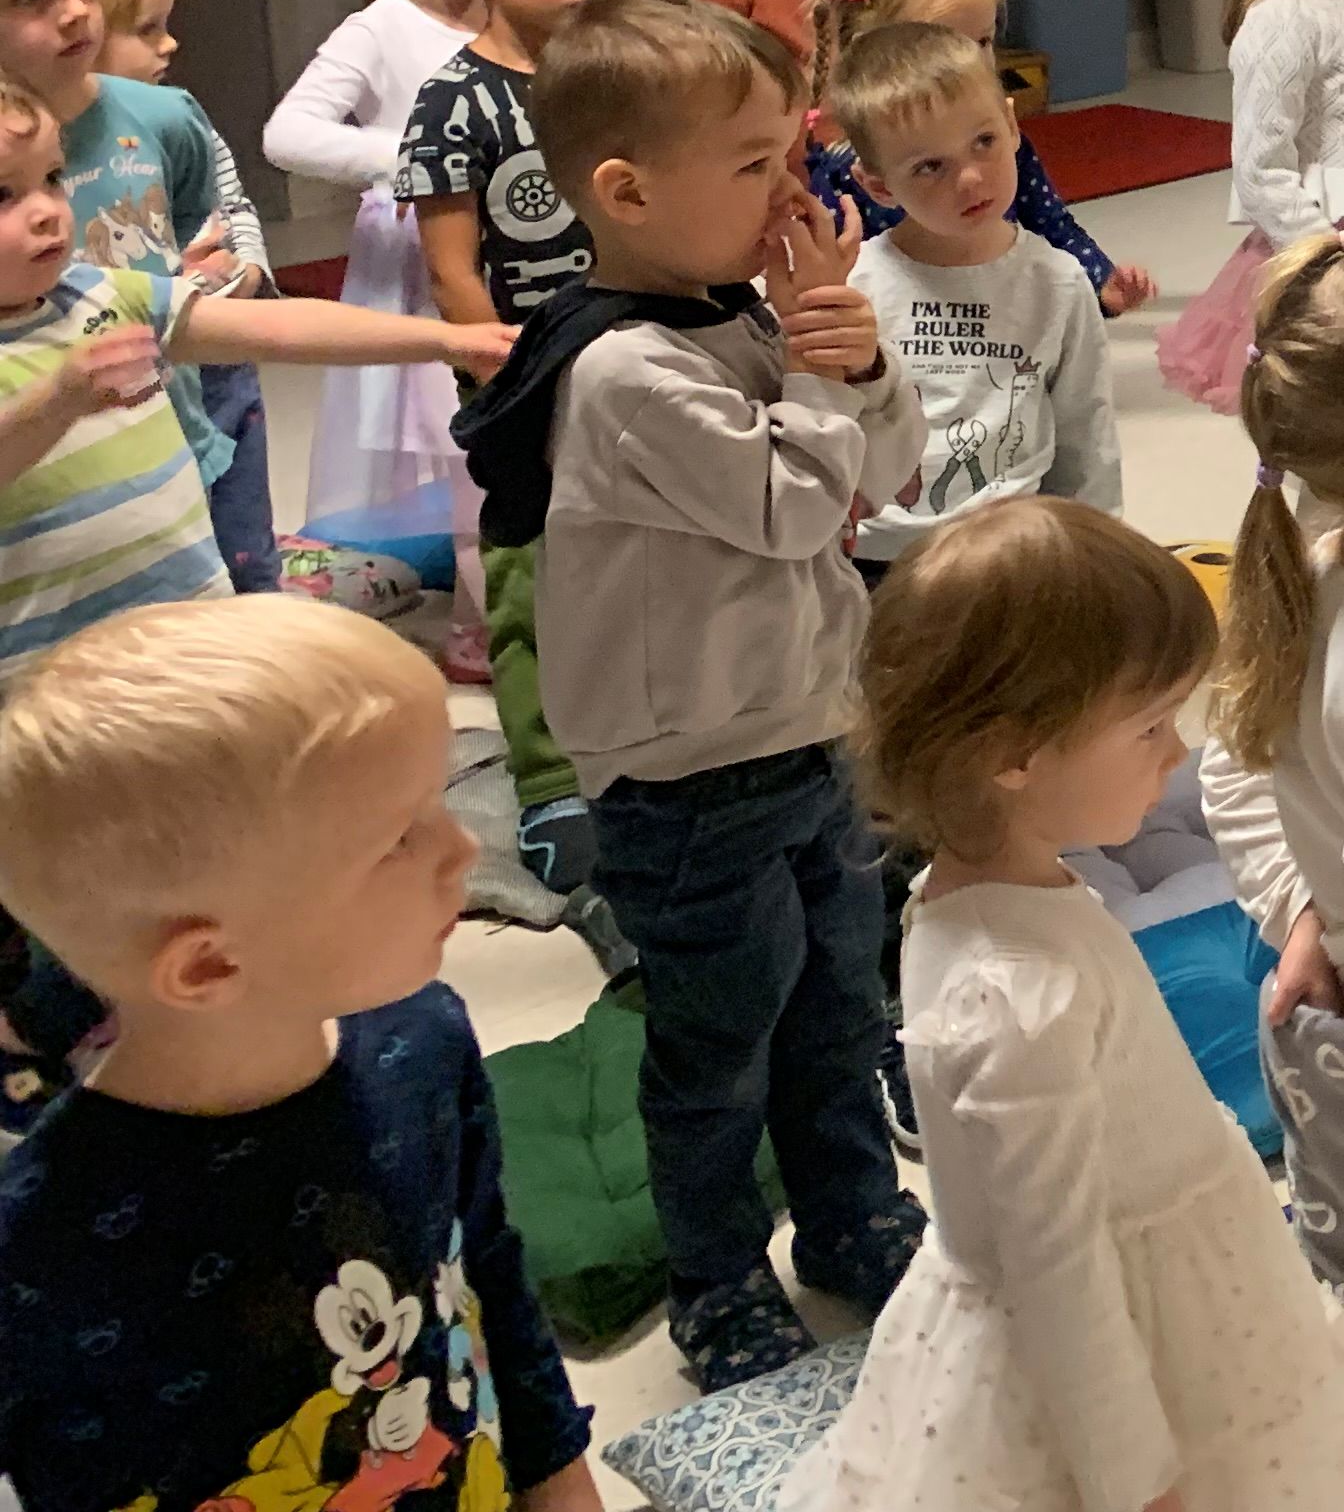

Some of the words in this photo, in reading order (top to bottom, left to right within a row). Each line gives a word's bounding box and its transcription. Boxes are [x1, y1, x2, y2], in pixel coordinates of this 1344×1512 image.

[911, 301, 942, 317] I'M
[946, 302, 991, 319] THE
[914, 321, 985, 338] RULER
[899, 340, 944, 356] THE
[949, 341, 1024, 359] WORLD
